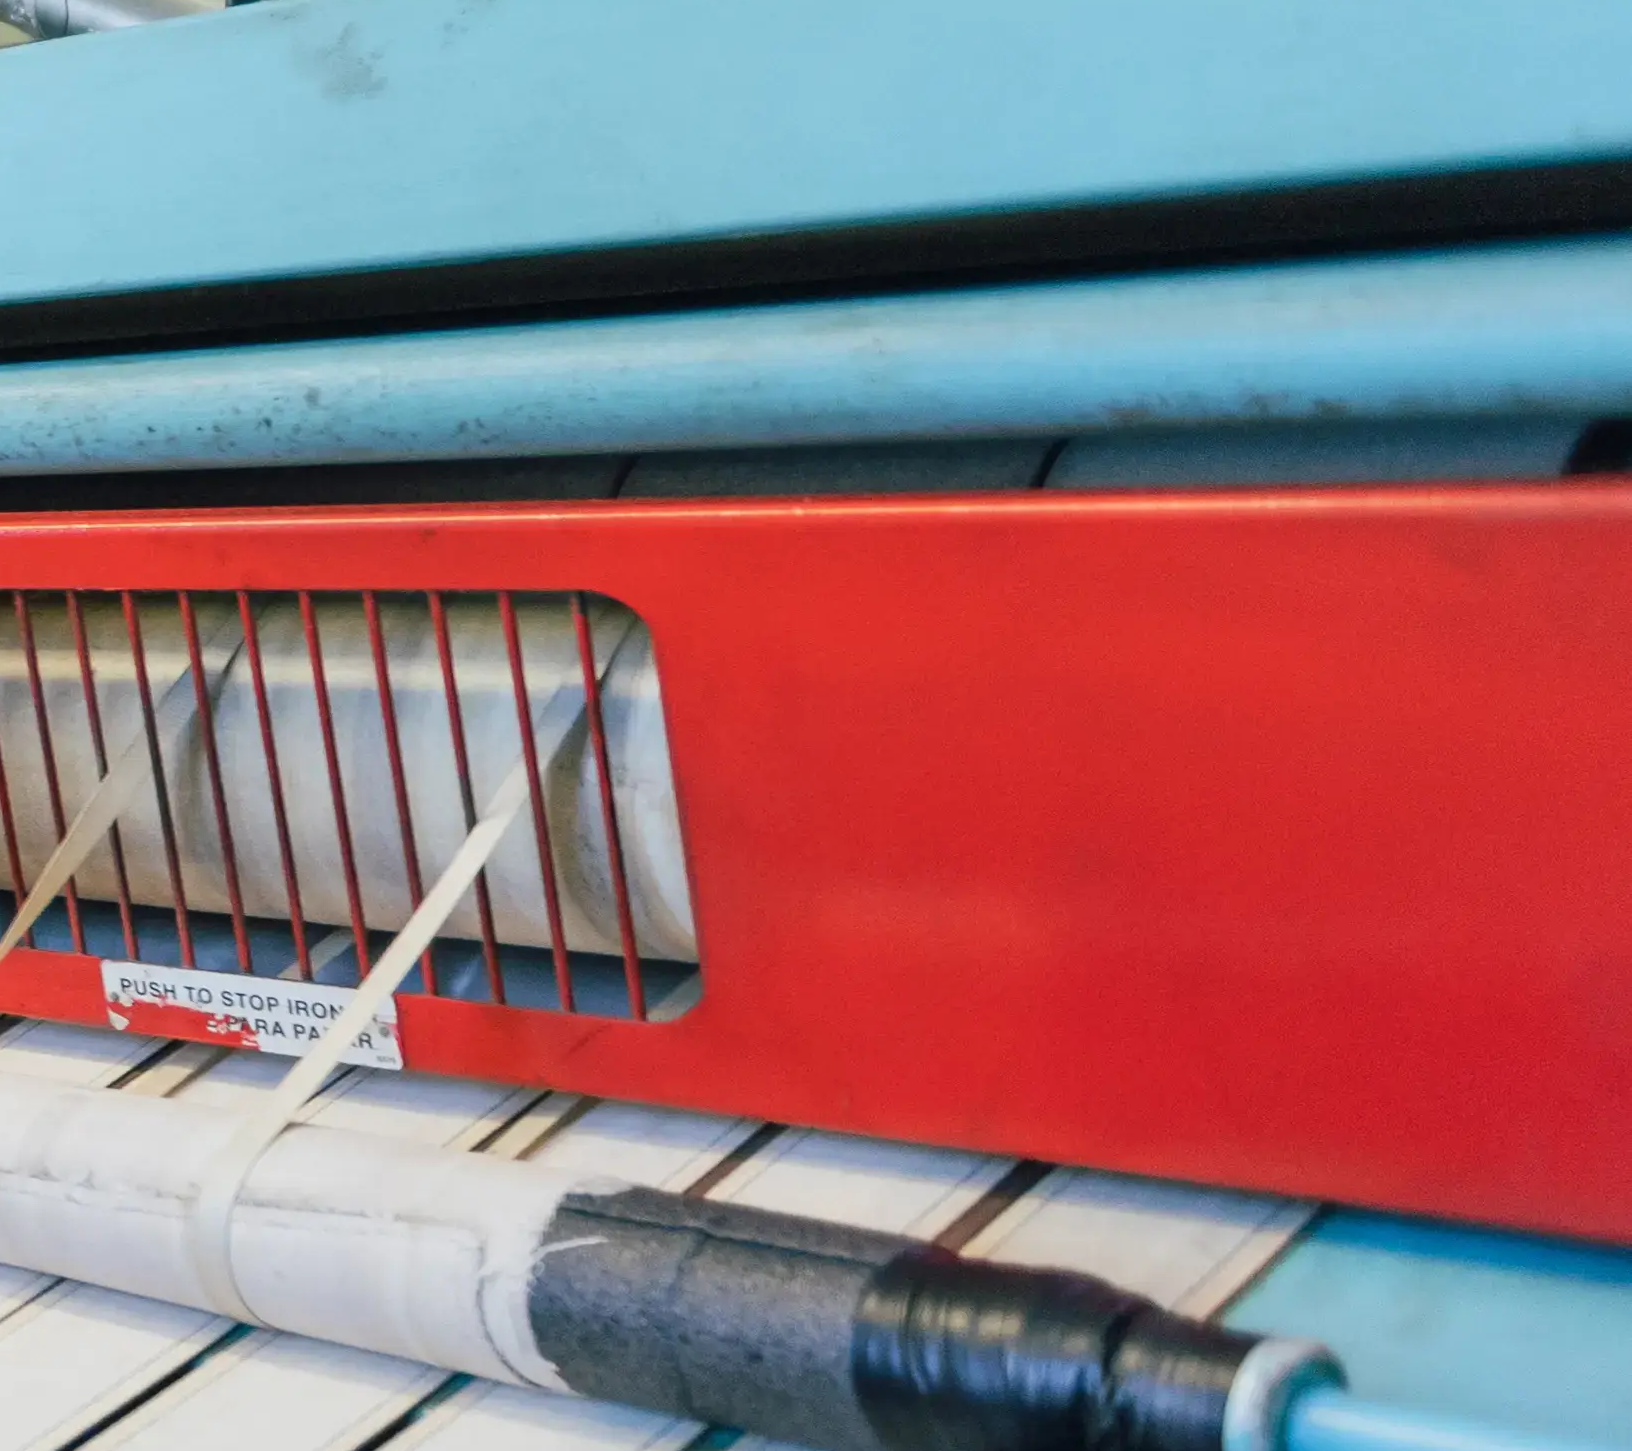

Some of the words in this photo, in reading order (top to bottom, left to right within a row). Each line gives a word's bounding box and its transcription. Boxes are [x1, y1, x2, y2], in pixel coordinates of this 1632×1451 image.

[119, 977, 178, 1000] PUSH
[183, 985, 213, 1005] TO
[220, 990, 280, 1013] STOP
[292, 1023, 374, 1050] PAR
